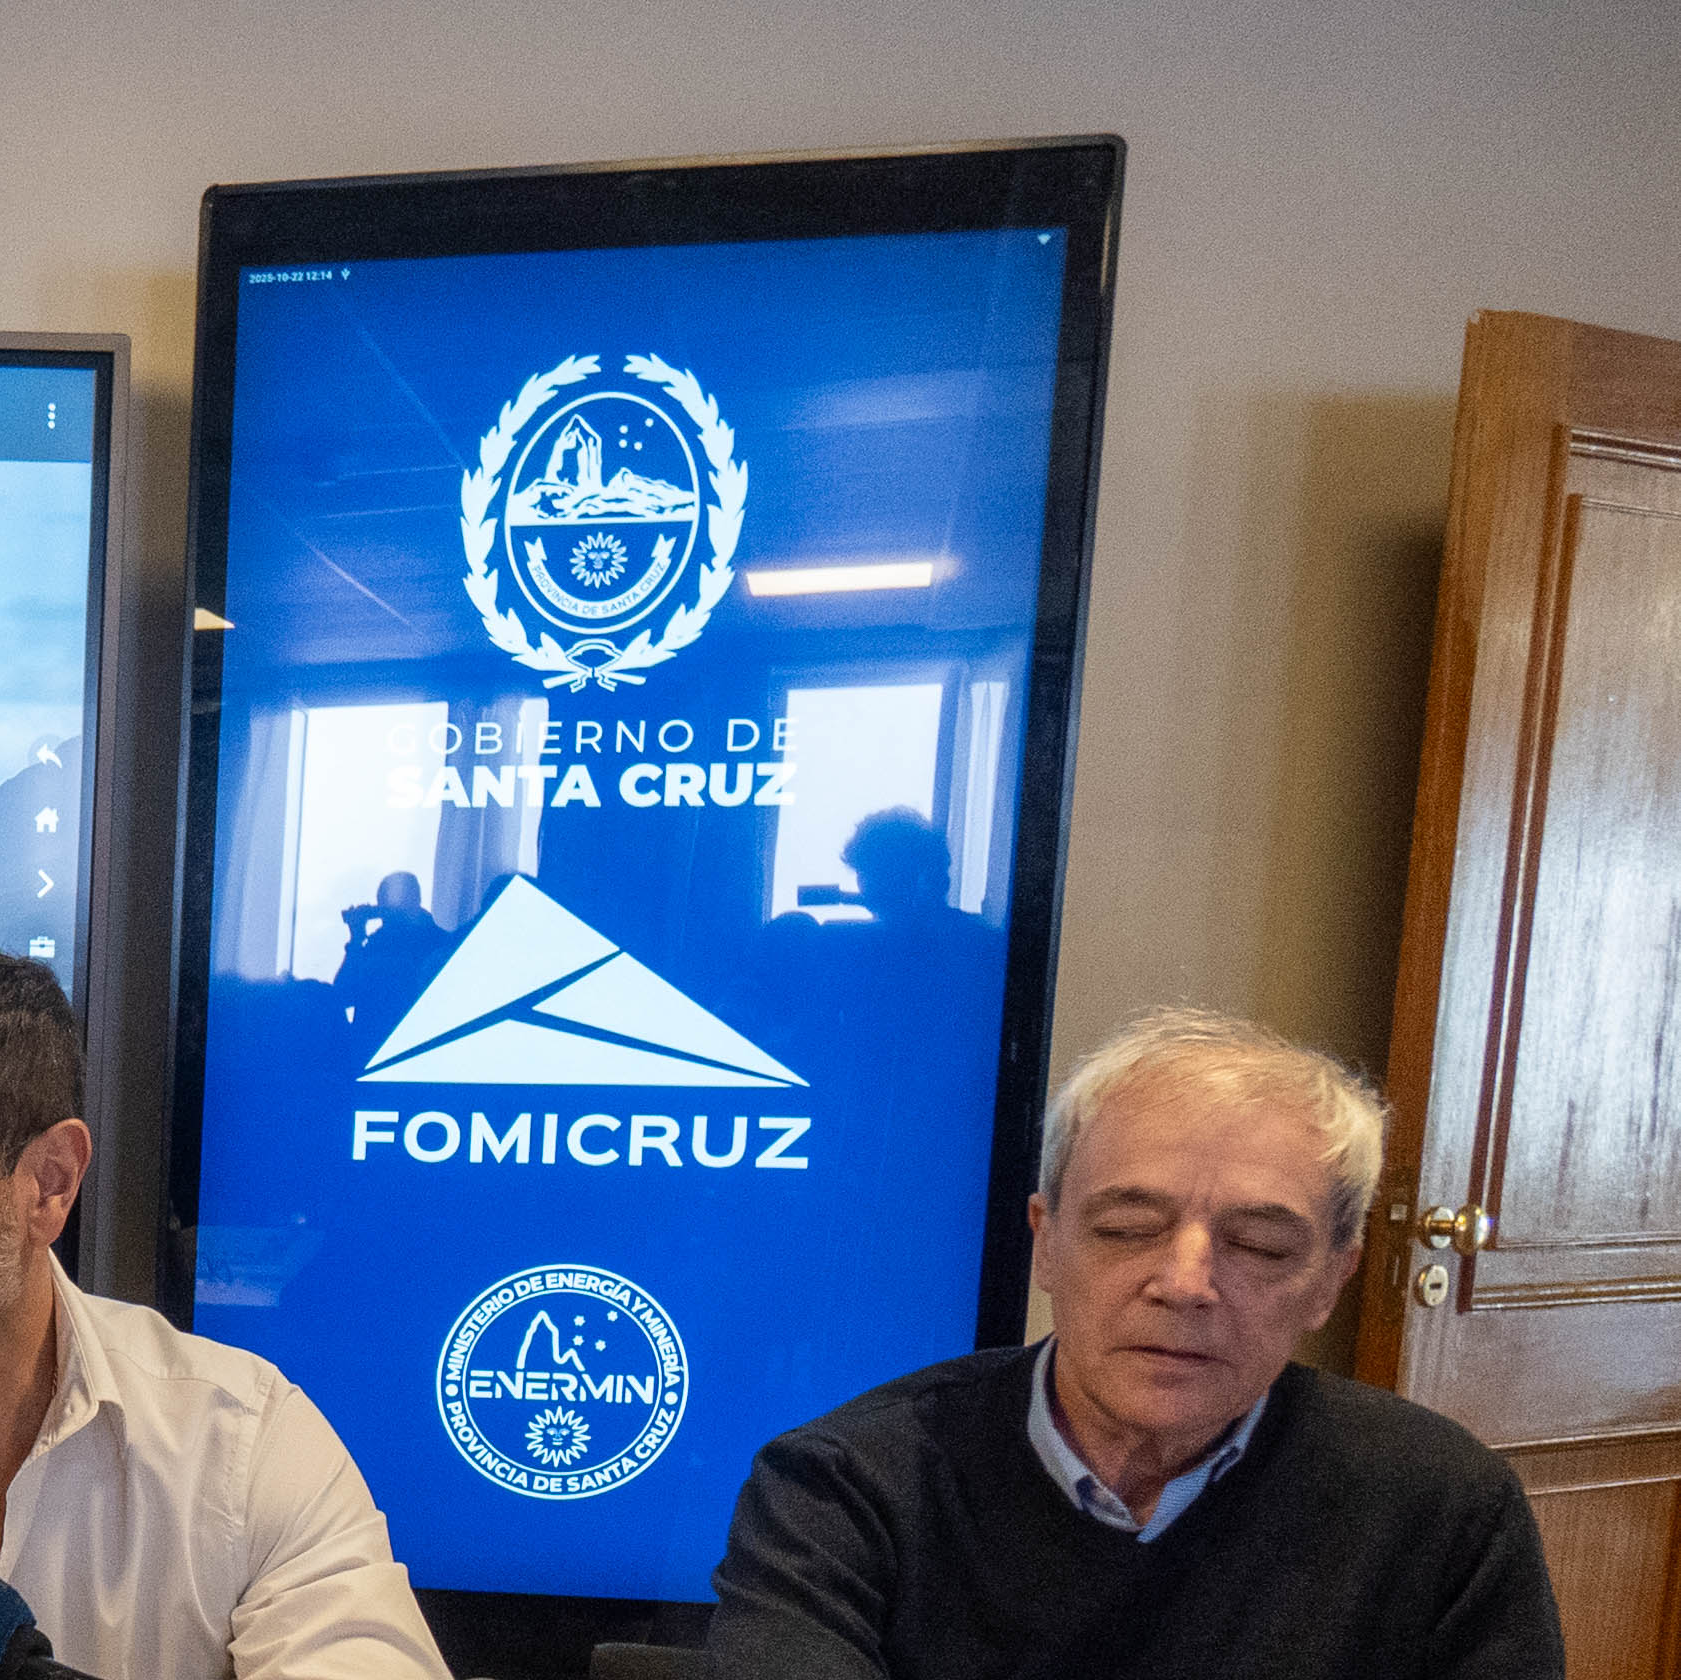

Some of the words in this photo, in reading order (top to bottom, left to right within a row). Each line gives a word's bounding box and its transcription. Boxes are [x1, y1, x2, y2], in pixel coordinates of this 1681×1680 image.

[249, 272, 304, 284] 2025-10-22
[306, 271, 333, 280] 12:14
[387, 719, 694, 755] GOBIERNO
[726, 718, 799, 753] DE
[385, 763, 601, 808] SANTA
[618, 762, 797, 807] CRUZ
[352, 1110, 812, 1169] FOMICRUZ
[446, 1288, 515, 1381] MINISTERIO
[513, 1276, 544, 1297] DE
[545, 1272, 631, 1306] ENERGÍA
[631, 1296, 646, 1313] Y
[640, 1309, 684, 1388] MINERÍA
[469, 1370, 655, 1404] ENERMIN
[446, 1401, 528, 1489] PROVINCIA
[532, 1476, 562, 1492] DE
[567, 1456, 639, 1492] SANTA
[635, 1407, 675, 1459] CRUZ
